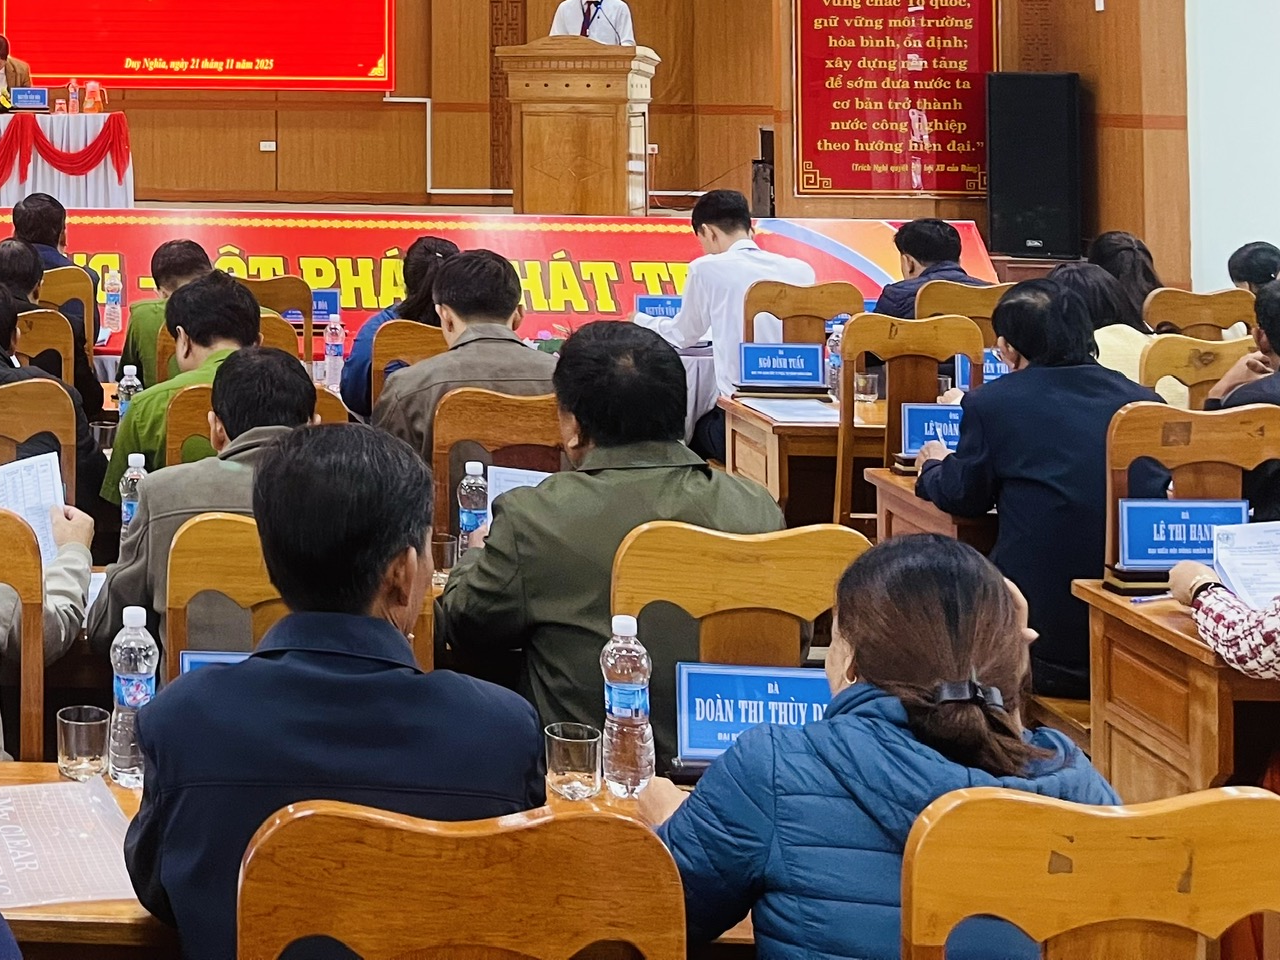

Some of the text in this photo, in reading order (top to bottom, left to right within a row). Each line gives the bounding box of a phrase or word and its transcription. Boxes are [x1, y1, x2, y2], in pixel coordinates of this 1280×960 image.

[814, 16, 973, 29] giữ vững môi trường
[828, 36, 856, 47] hòa
[860, 36, 900, 49] bình,
[926, 36, 968, 50] định;
[124, 58, 141, 71] Duy
[142, 58, 168, 71] Nghĩa,
[170, 59, 189, 71] ngày
[190, 58, 199, 69] 21
[201, 58, 224, 72] tháng
[236, 59, 253, 69] năm
[255, 59, 274, 70] 2025
[512, 250, 619, 312] HÁT
[1153, 520, 1166, 541] LÊ
[1168, 524, 1187, 543] THỊ
[768, 682, 780, 694] BÀ
[695, 694, 734, 722] ĐOÀN
[738, 700, 764, 726] THỊ
[768, 698, 808, 726] THÙY
[0, 825, 39, 872] CLEAR
